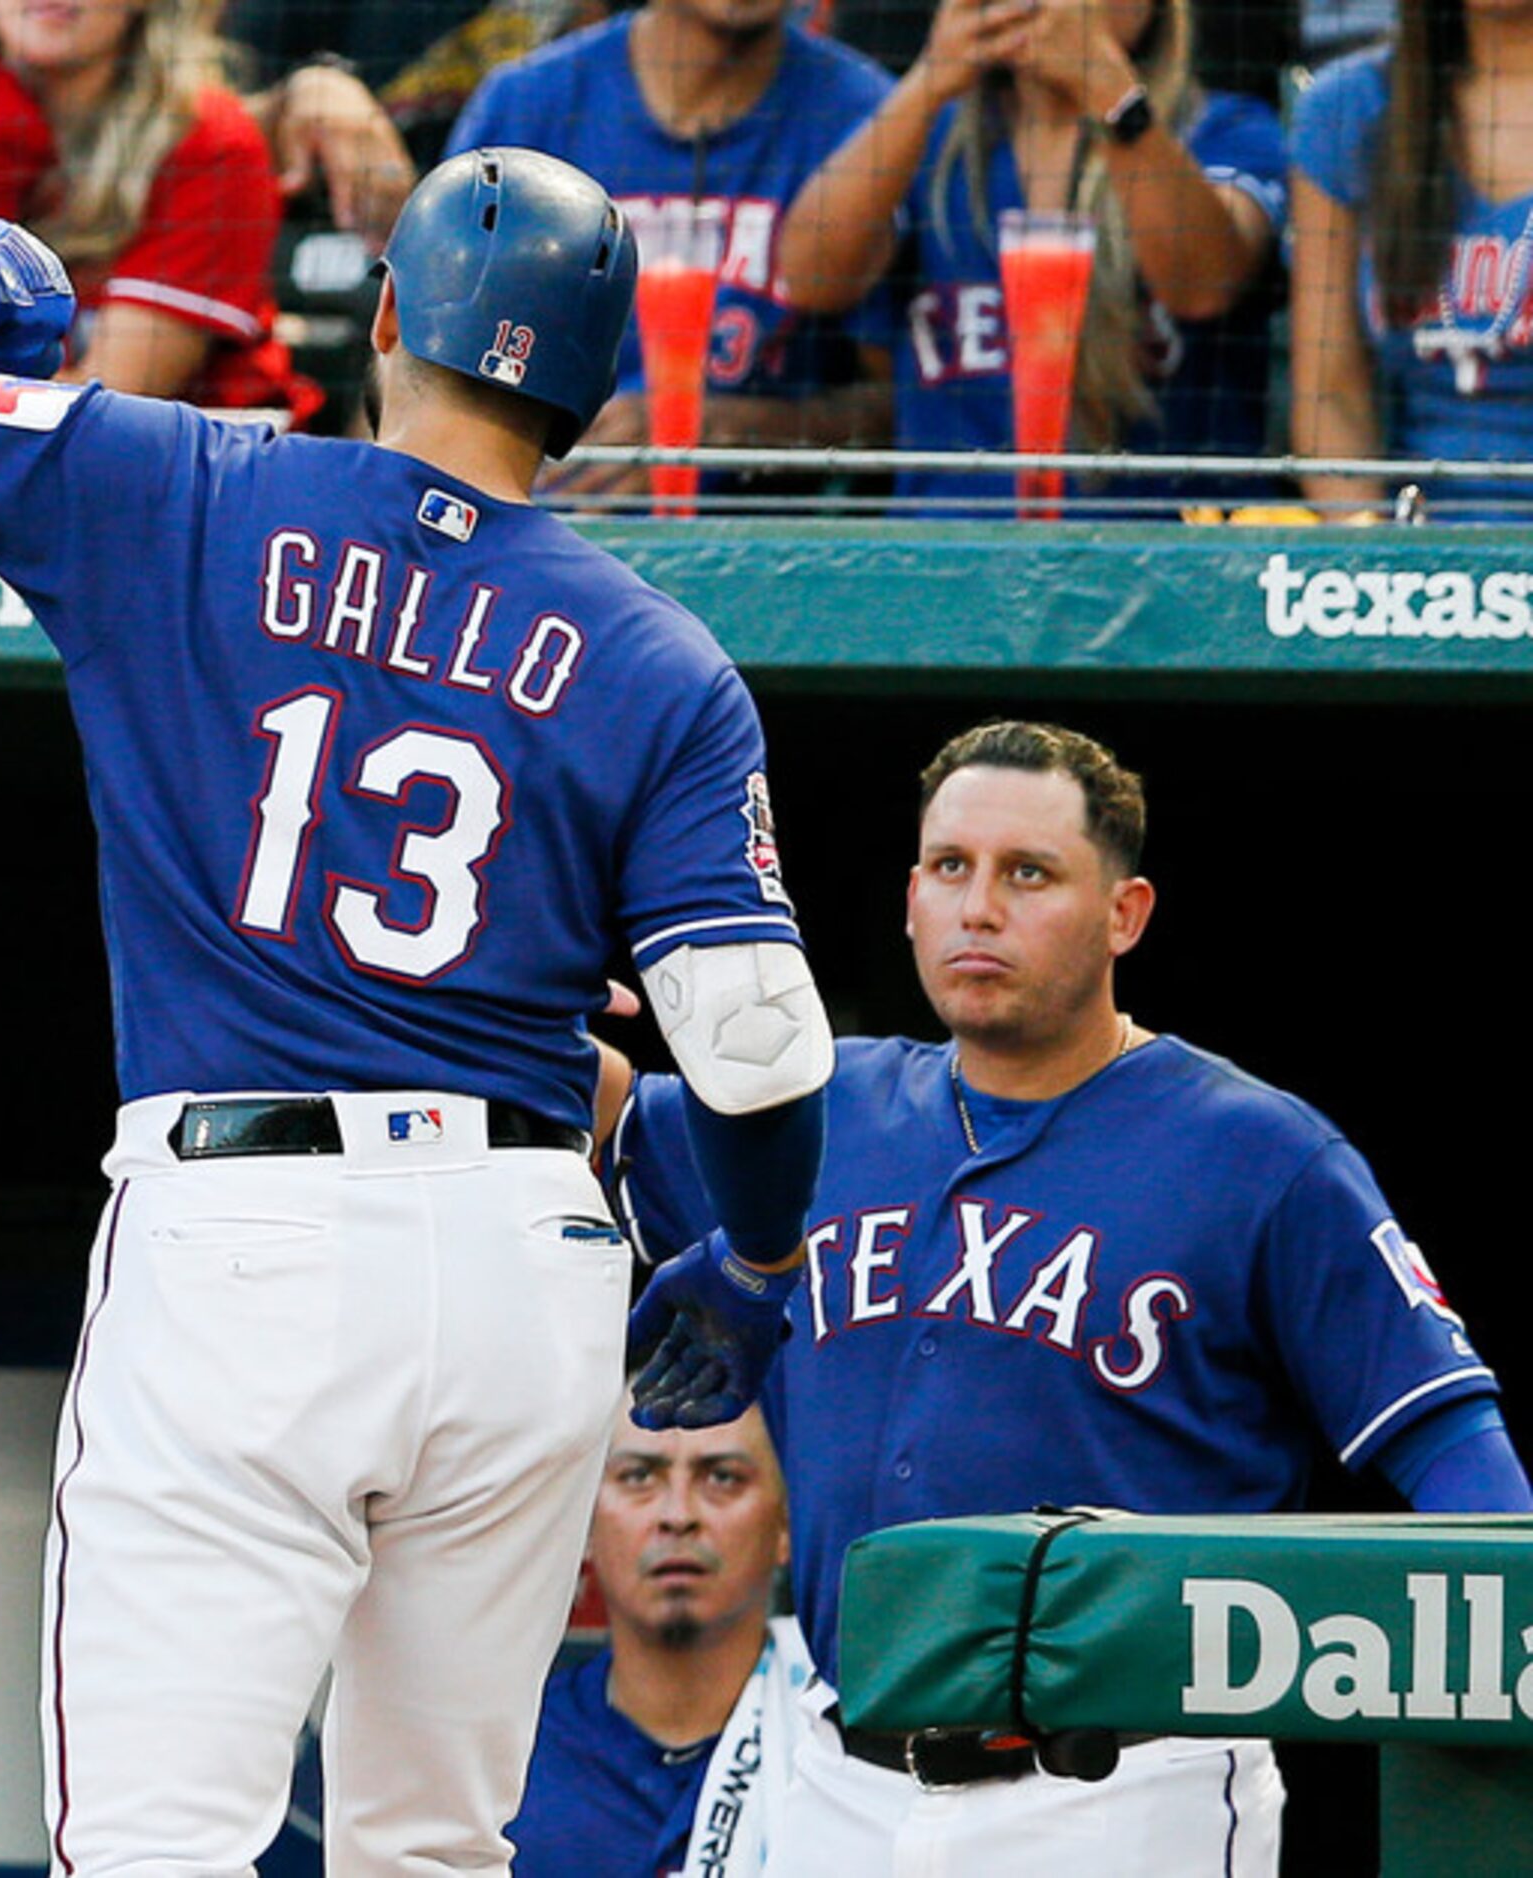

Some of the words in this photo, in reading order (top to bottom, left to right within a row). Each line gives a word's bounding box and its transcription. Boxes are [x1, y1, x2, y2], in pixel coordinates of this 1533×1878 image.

[493, 319, 536, 360] 13
[260, 527, 585, 718] GALLO
[1258, 553, 1533, 640] texas
[231, 684, 513, 988] 13
[806, 1195, 1196, 1394] TEXAS
[1181, 1574, 1533, 1722] Dall
